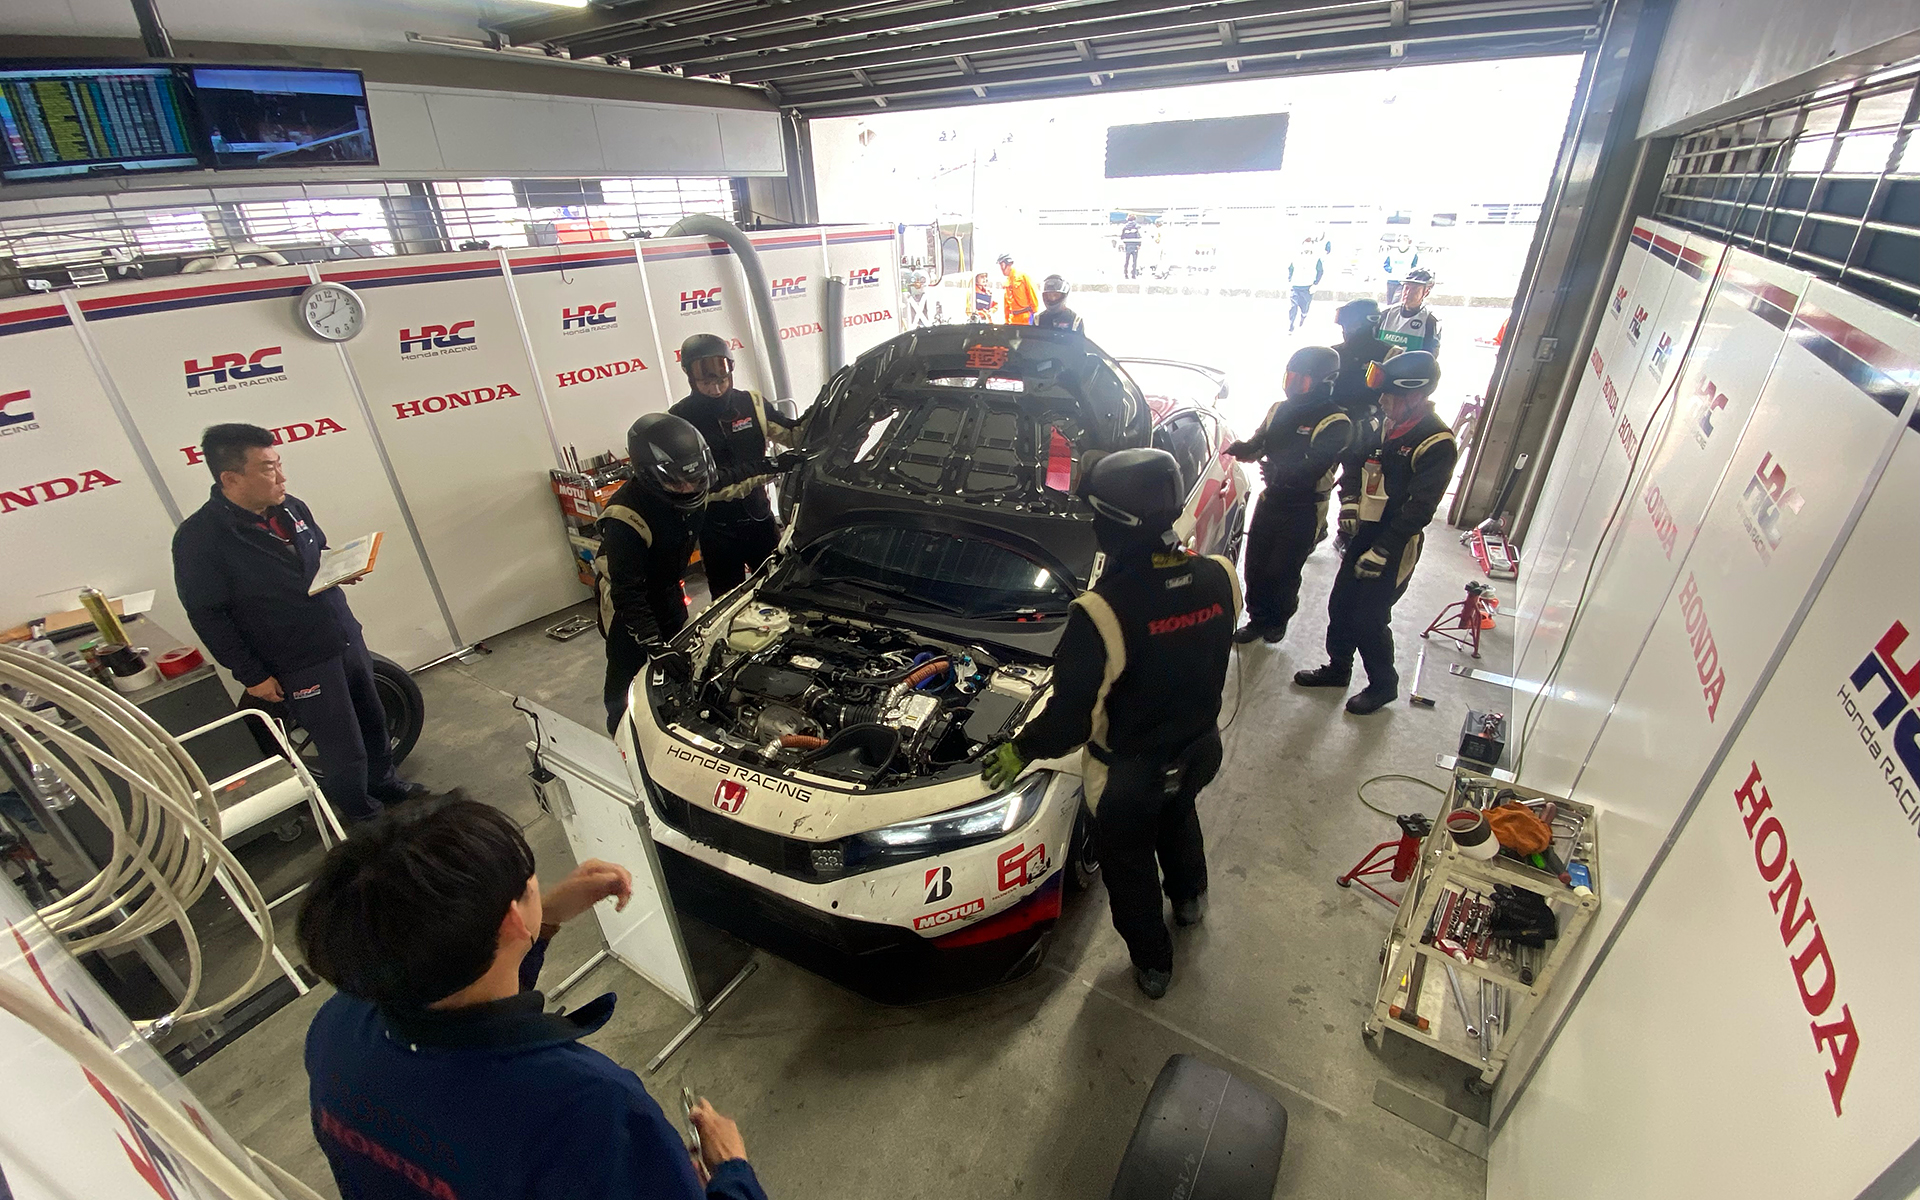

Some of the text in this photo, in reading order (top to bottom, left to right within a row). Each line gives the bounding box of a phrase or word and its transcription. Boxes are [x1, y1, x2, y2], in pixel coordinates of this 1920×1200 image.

[771, 276, 807, 297] HRC
[849, 267, 880, 286] HRC
[680, 287, 722, 312] HRC
[562, 301, 617, 330] HRC
[591, 322, 618, 332] RACING
[843, 310, 893, 328] HONDA
[400, 320, 476, 354] HRC
[779, 322, 824, 340] ONDA
[1384, 333, 1408, 344] MEDIA
[184, 346, 284, 389] HRC
[401, 345, 478, 361] Honda RACING
[188, 374, 288, 397] Honda RACING
[556, 358, 648, 388] HONDA
[392, 383, 521, 420] HONDA
[0, 422, 40, 437] CING
[0, 469, 122, 513] NDA
[1148, 603, 1223, 635] HONDA
[1679, 571, 1726, 724] HONDA
[1837, 684, 1881, 760] Honda
[666, 745, 813, 803] Honda RACING
[919, 901, 982, 929] MOTUL
[1734, 760, 1860, 1118] HONDA
[319, 1107, 458, 1200] HONDA
